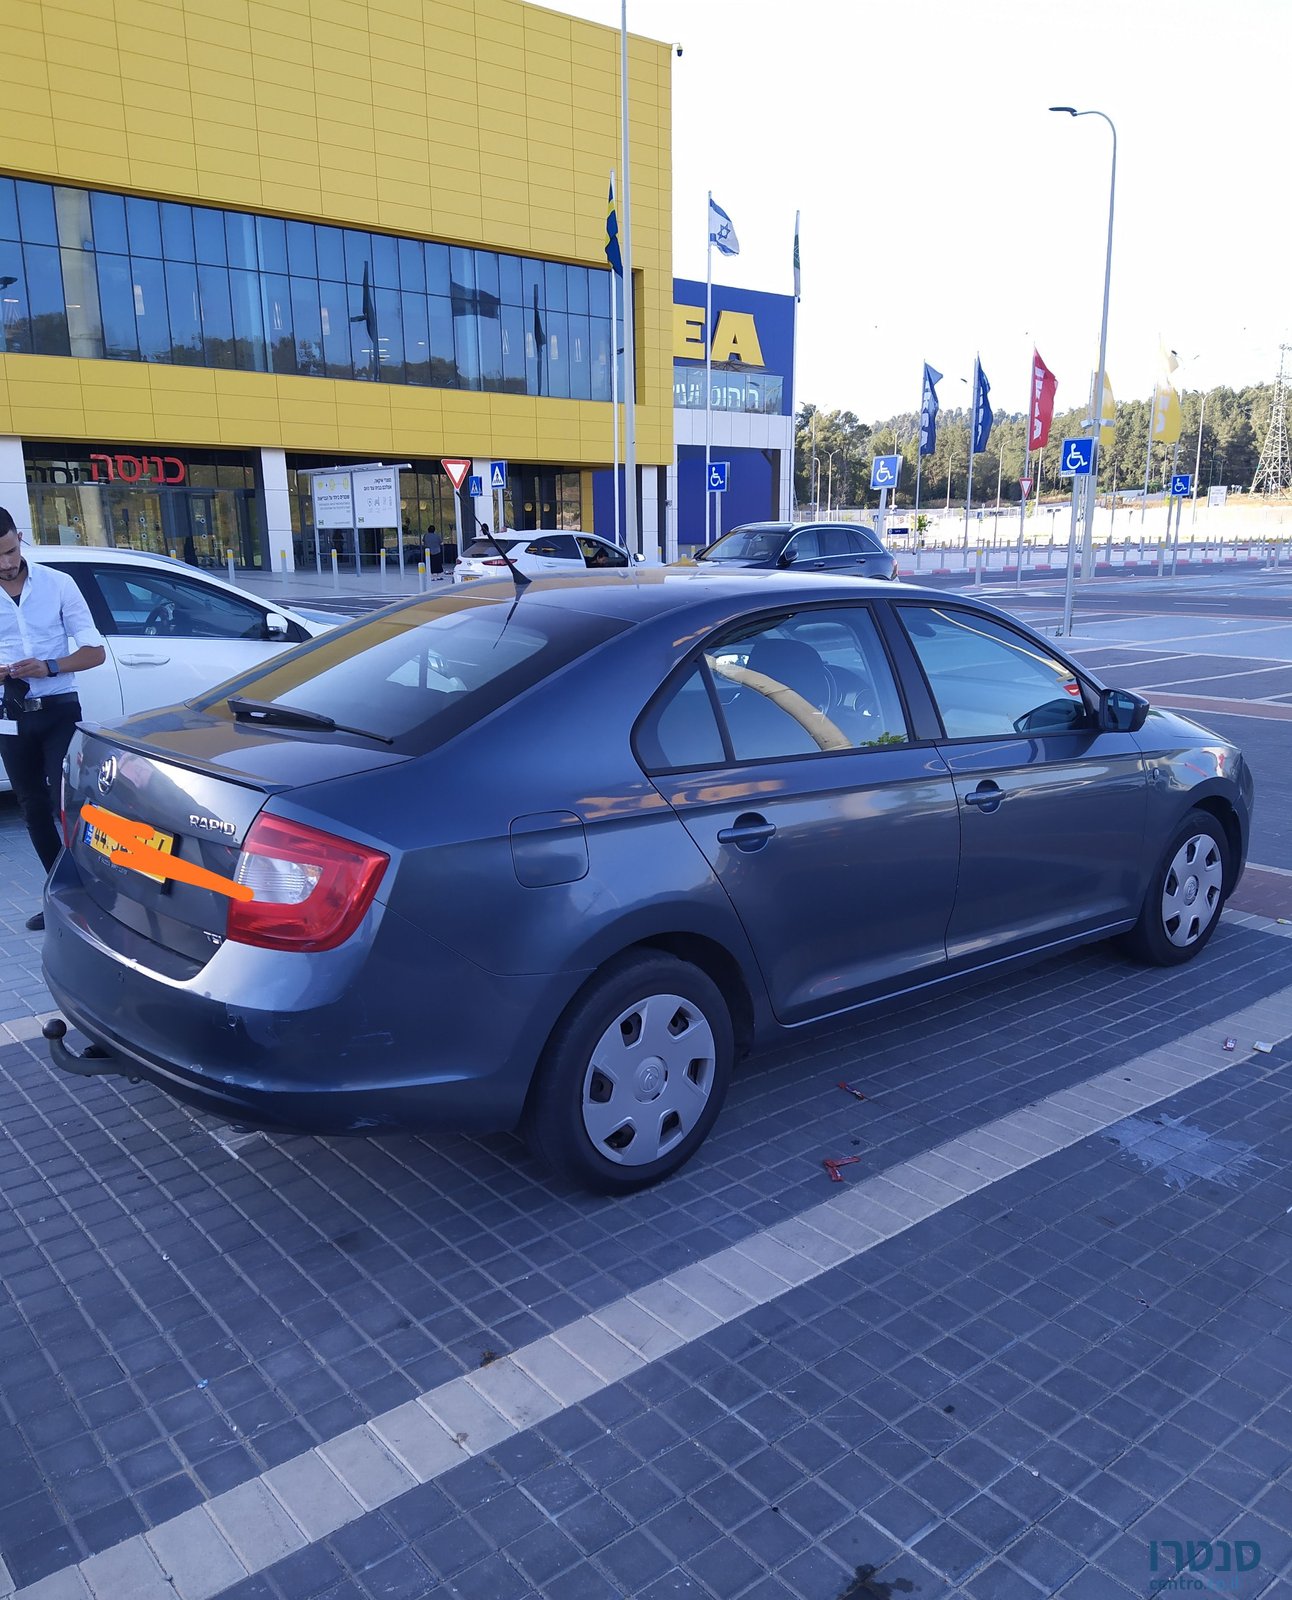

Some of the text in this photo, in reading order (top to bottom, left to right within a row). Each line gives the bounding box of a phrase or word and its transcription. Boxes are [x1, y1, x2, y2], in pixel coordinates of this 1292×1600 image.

[673, 383, 700, 406] ועי
[89, 453, 186, 483] כניסה
[189, 814, 236, 835] RAPID
